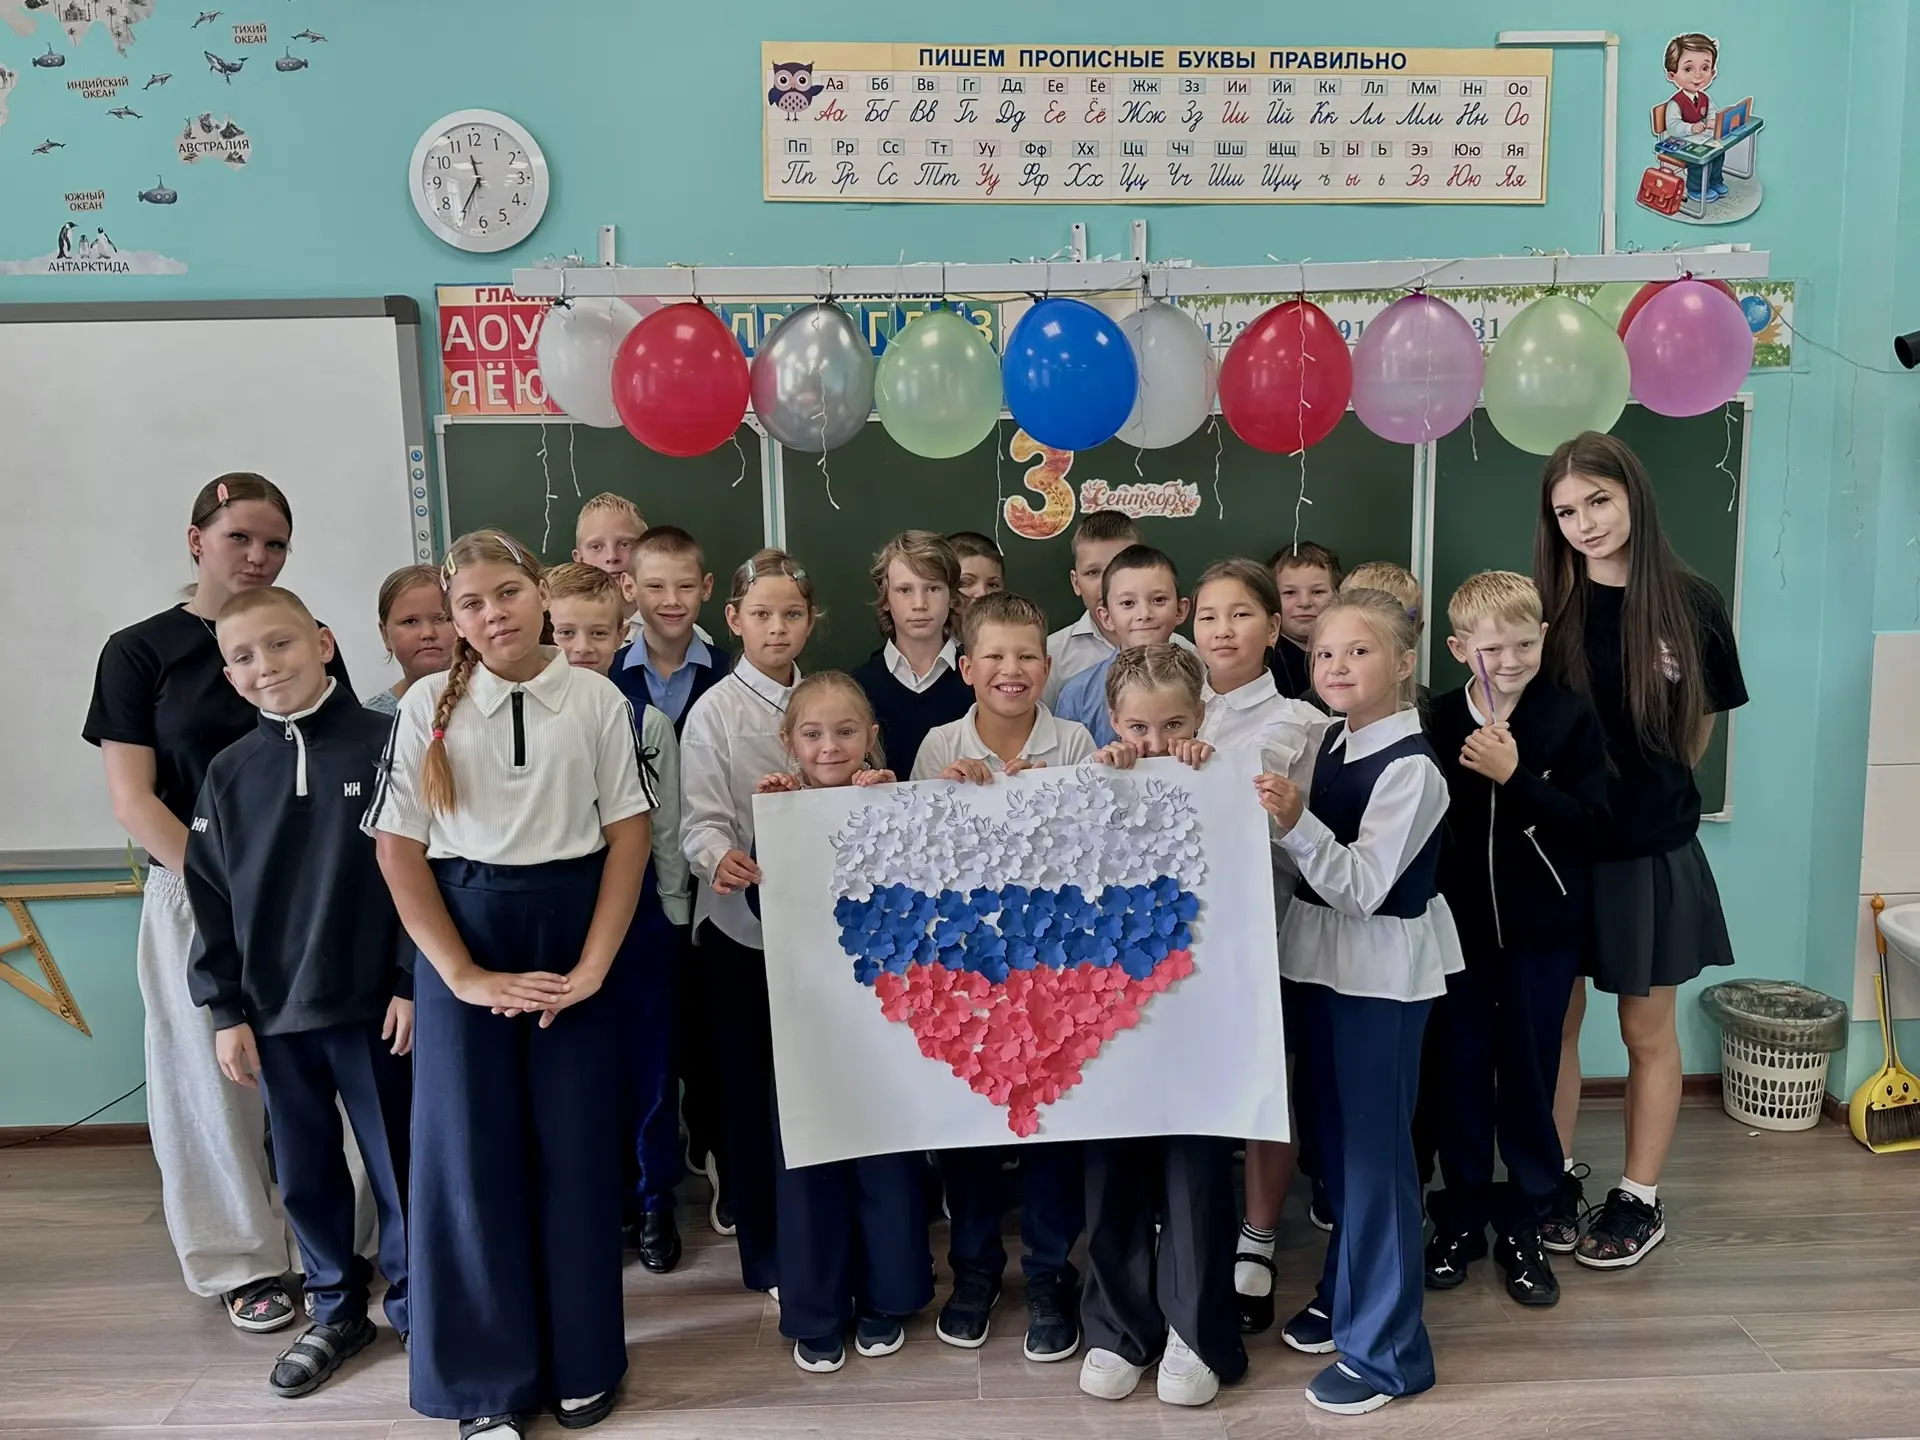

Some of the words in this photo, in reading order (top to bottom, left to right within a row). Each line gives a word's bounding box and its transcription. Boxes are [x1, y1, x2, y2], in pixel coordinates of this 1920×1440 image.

[232, 24, 267, 33] ТИХИЙ
[234, 34, 267, 43] ОКЕАН
[919, 49, 1005, 67] ПИШЕМ
[1020, 48, 1164, 68] ПРОПИСНЫЕ
[1179, 51, 1255, 69] БУКВЫ
[1270, 52, 1406, 70] ПРАВИЛЬНО
[67, 77, 129, 90] ИНДИЙСКИЙ
[826, 78, 843, 90] Аа
[872, 77, 889, 91] Бб
[918, 78, 934, 91] Вв
[963, 79, 975, 91] Гг
[1001, 79, 1022, 94] Дд
[1048, 80, 1064, 92] Ее
[1090, 77, 1106, 92] Ёё
[1133, 79, 1158, 92] Жж
[1185, 80, 1199, 93] Зз
[1228, 81, 1247, 93] Ии
[1273, 79, 1291, 93] Йй
[1320, 81, 1336, 94] Кк
[1365, 82, 1383, 94] Лл
[1412, 82, 1436, 95] Мм
[1464, 83, 1482, 95] Нн
[1509, 83, 1528, 95] Оо
[83, 89, 116, 98] ОКЕАН
[468, 133, 481, 146] 12
[494, 138, 498, 150] 1
[178, 140, 249, 153] АВСТРАЛИЯ
[450, 141, 460, 153] 11
[788, 140, 807, 153] Пп
[836, 141, 854, 156] Рр
[883, 141, 899, 153] Сс
[931, 142, 947, 154] Тт
[979, 142, 995, 157] Уу
[1025, 142, 1046, 157] Фф
[1077, 142, 1094, 155] Хх
[1124, 142, 1143, 157] Цц
[1172, 143, 1188, 155] Чч
[1218, 143, 1244, 155] Шш
[1269, 143, 1296, 157] Щщ
[1411, 144, 1428, 156] Ээ
[1455, 144, 1480, 156] Юю
[1507, 144, 1523, 157] Яя
[437, 156, 450, 169] 10
[509, 152, 515, 165] 2
[433, 176, 441, 189] 9
[517, 171, 524, 184] 3
[65, 190, 105, 201] ЮЖНЫЙ
[512, 193, 520, 205] 4
[70, 201, 102, 210] ОКЕАН
[442, 197, 450, 210] 8
[499, 209, 507, 221] 5
[479, 216, 488, 228] 6
[49, 262, 129, 273] АНТАРКТИДА
[1004, 428, 1075, 539] 3
[1092, 483, 1187, 514] Сентября
